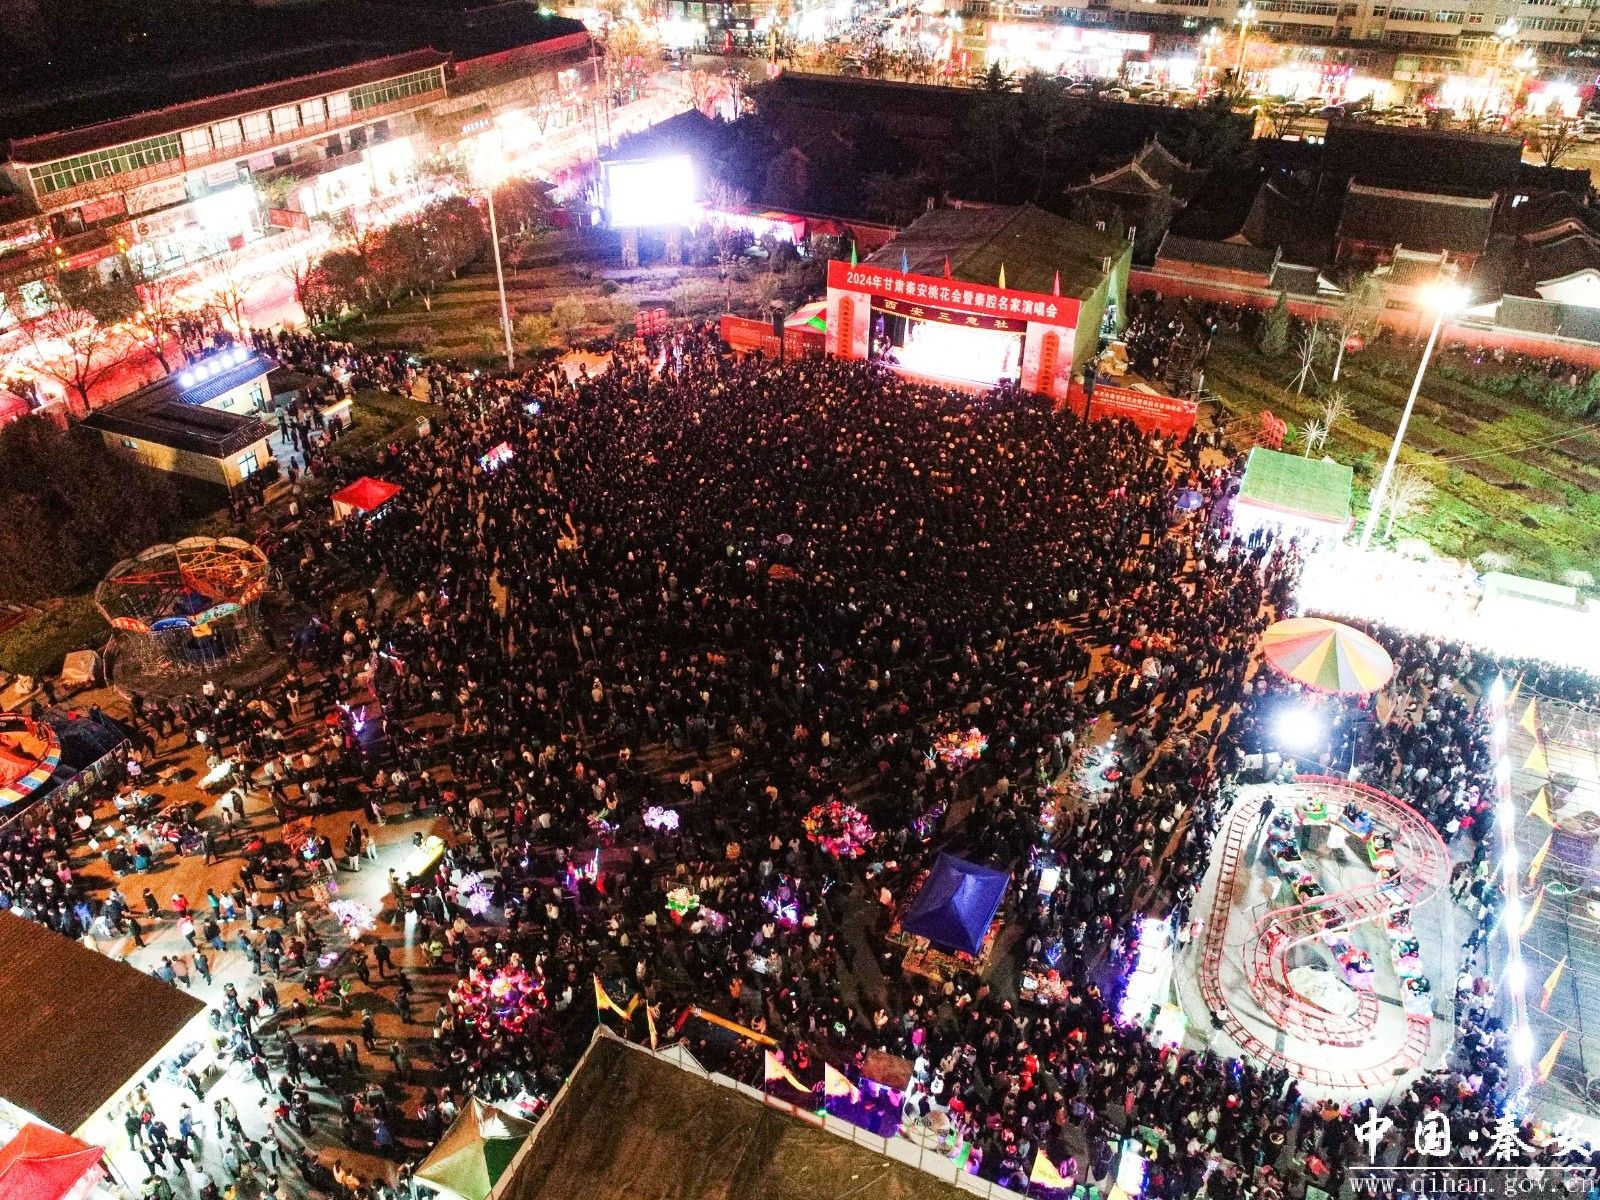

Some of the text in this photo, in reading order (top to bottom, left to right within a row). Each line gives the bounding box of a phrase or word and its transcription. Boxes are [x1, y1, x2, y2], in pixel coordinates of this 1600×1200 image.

[846, 271, 1058, 319] 2024年甘肃秦安桃花会暨秦腔名家演唱会
